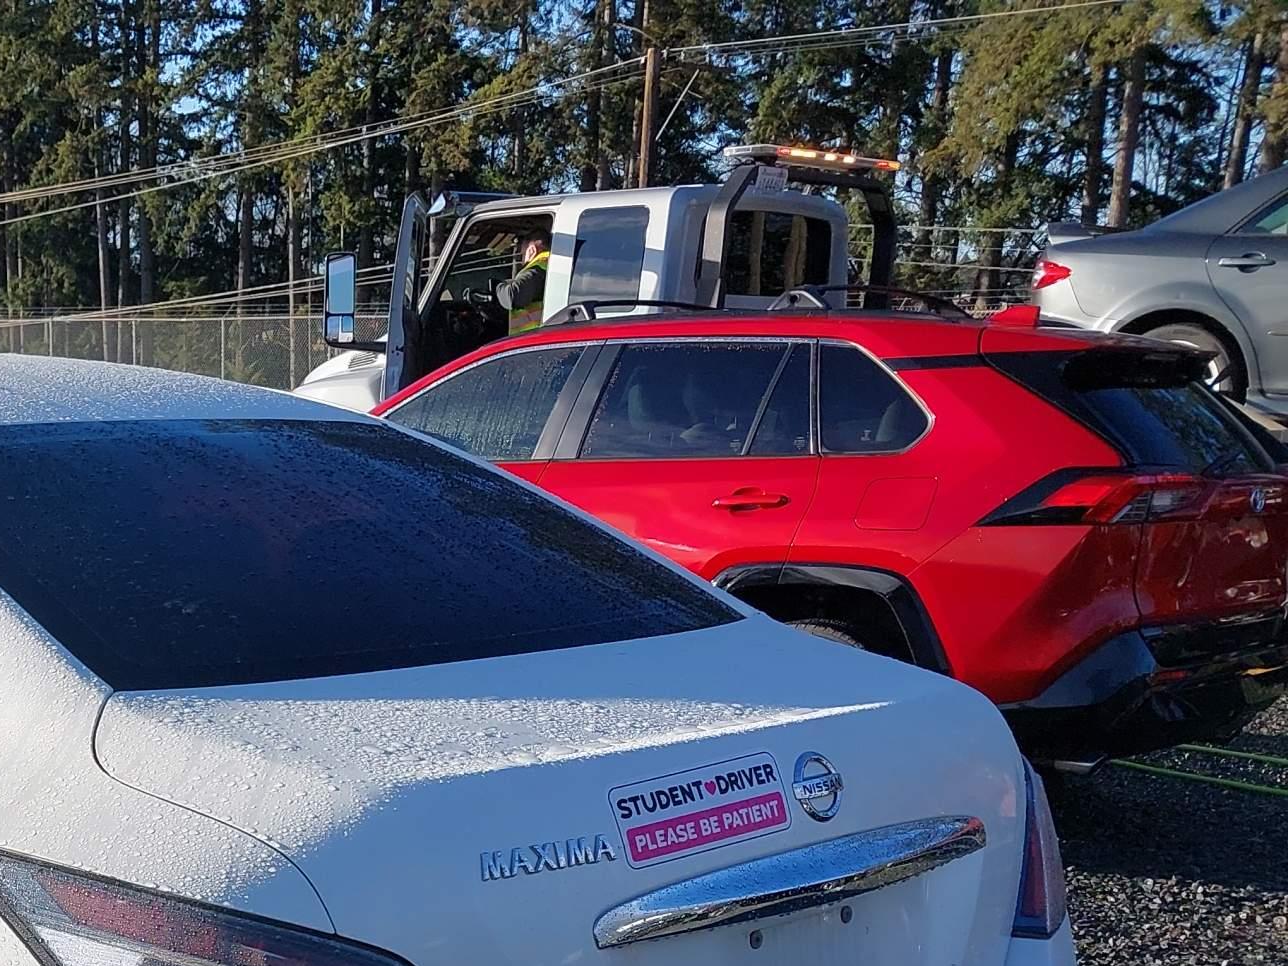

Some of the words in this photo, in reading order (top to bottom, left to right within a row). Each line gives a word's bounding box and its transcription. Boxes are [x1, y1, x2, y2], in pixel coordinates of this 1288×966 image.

[616, 780, 705, 819] STUDENT
[715, 763, 778, 796] DRIVER
[802, 775, 843, 796] NISSAN
[634, 823, 698, 853] PLEASE
[699, 816, 721, 836] BE
[723, 800, 780, 830] PATIENT
[480, 833, 617, 881] MAXIMA
